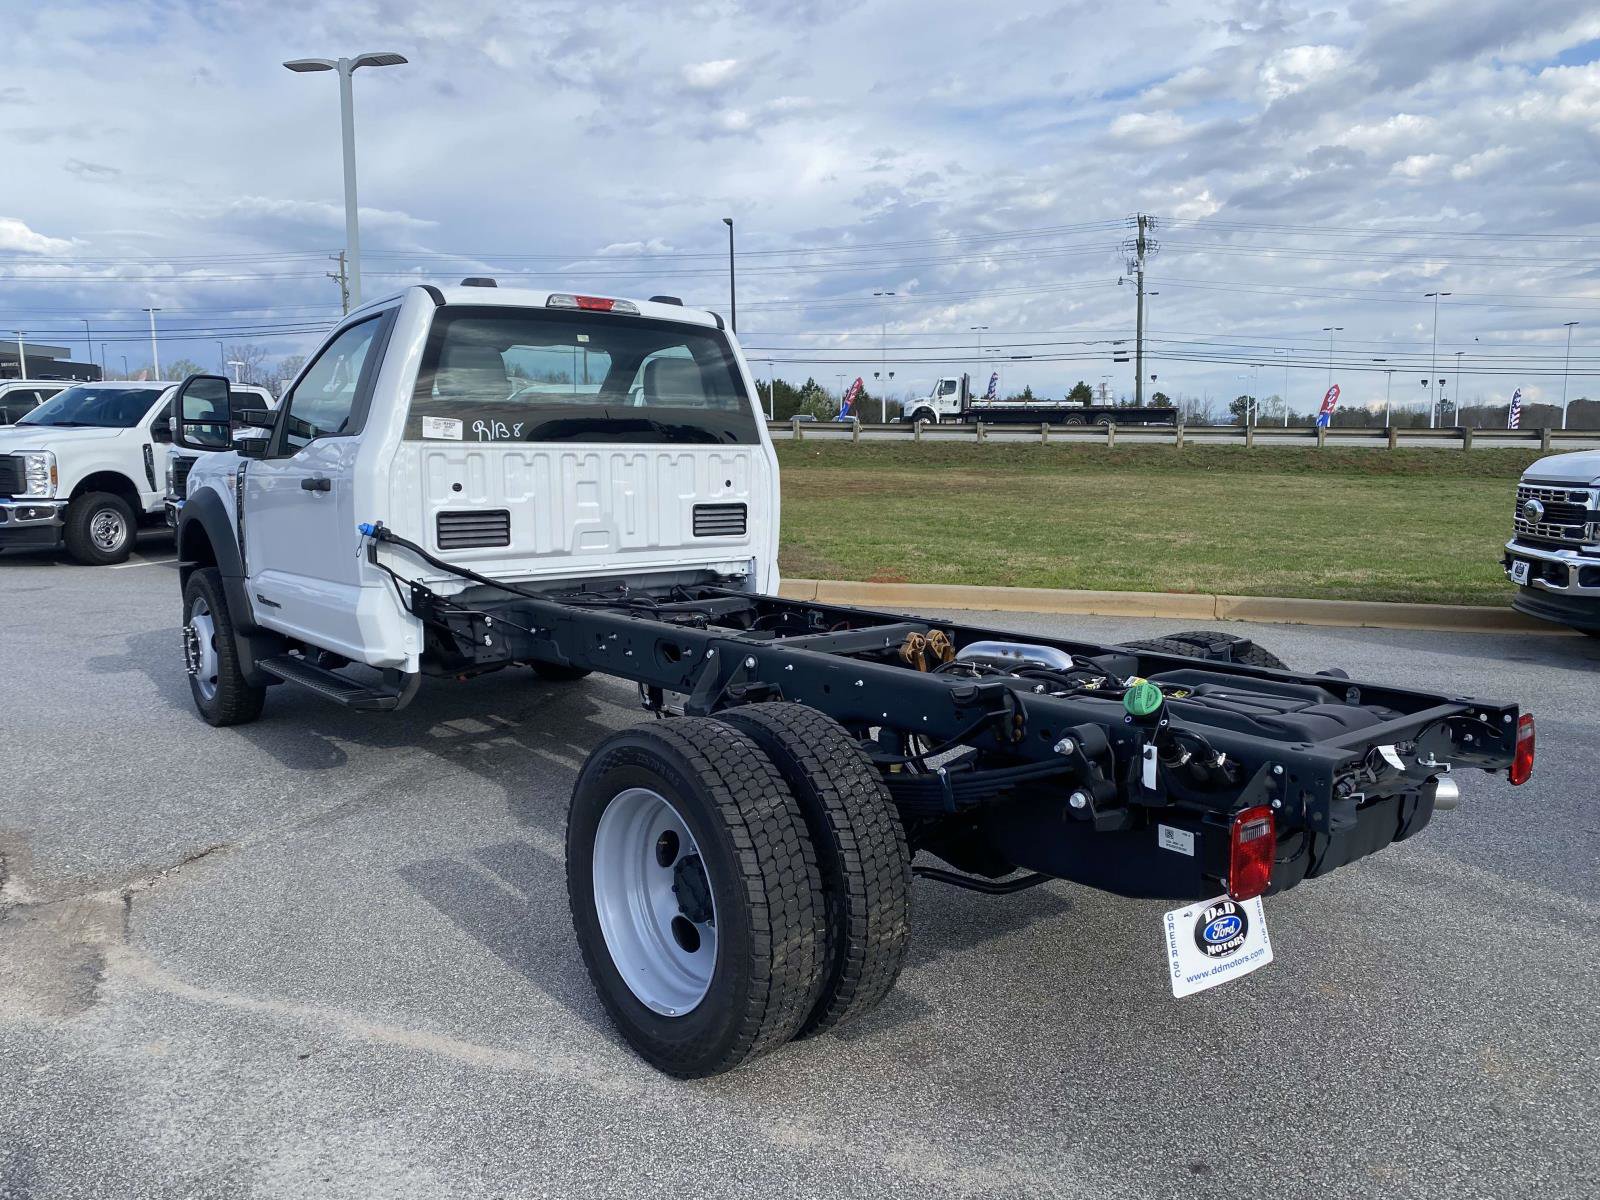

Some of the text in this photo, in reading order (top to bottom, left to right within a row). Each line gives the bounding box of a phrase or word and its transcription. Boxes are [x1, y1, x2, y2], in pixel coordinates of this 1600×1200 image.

[1204, 902, 1236, 924] D&D
[1212, 919, 1236, 940] Ford
[1206, 932, 1245, 956] MOTORS
[1185, 948, 1265, 983] www.ddmotors.com
